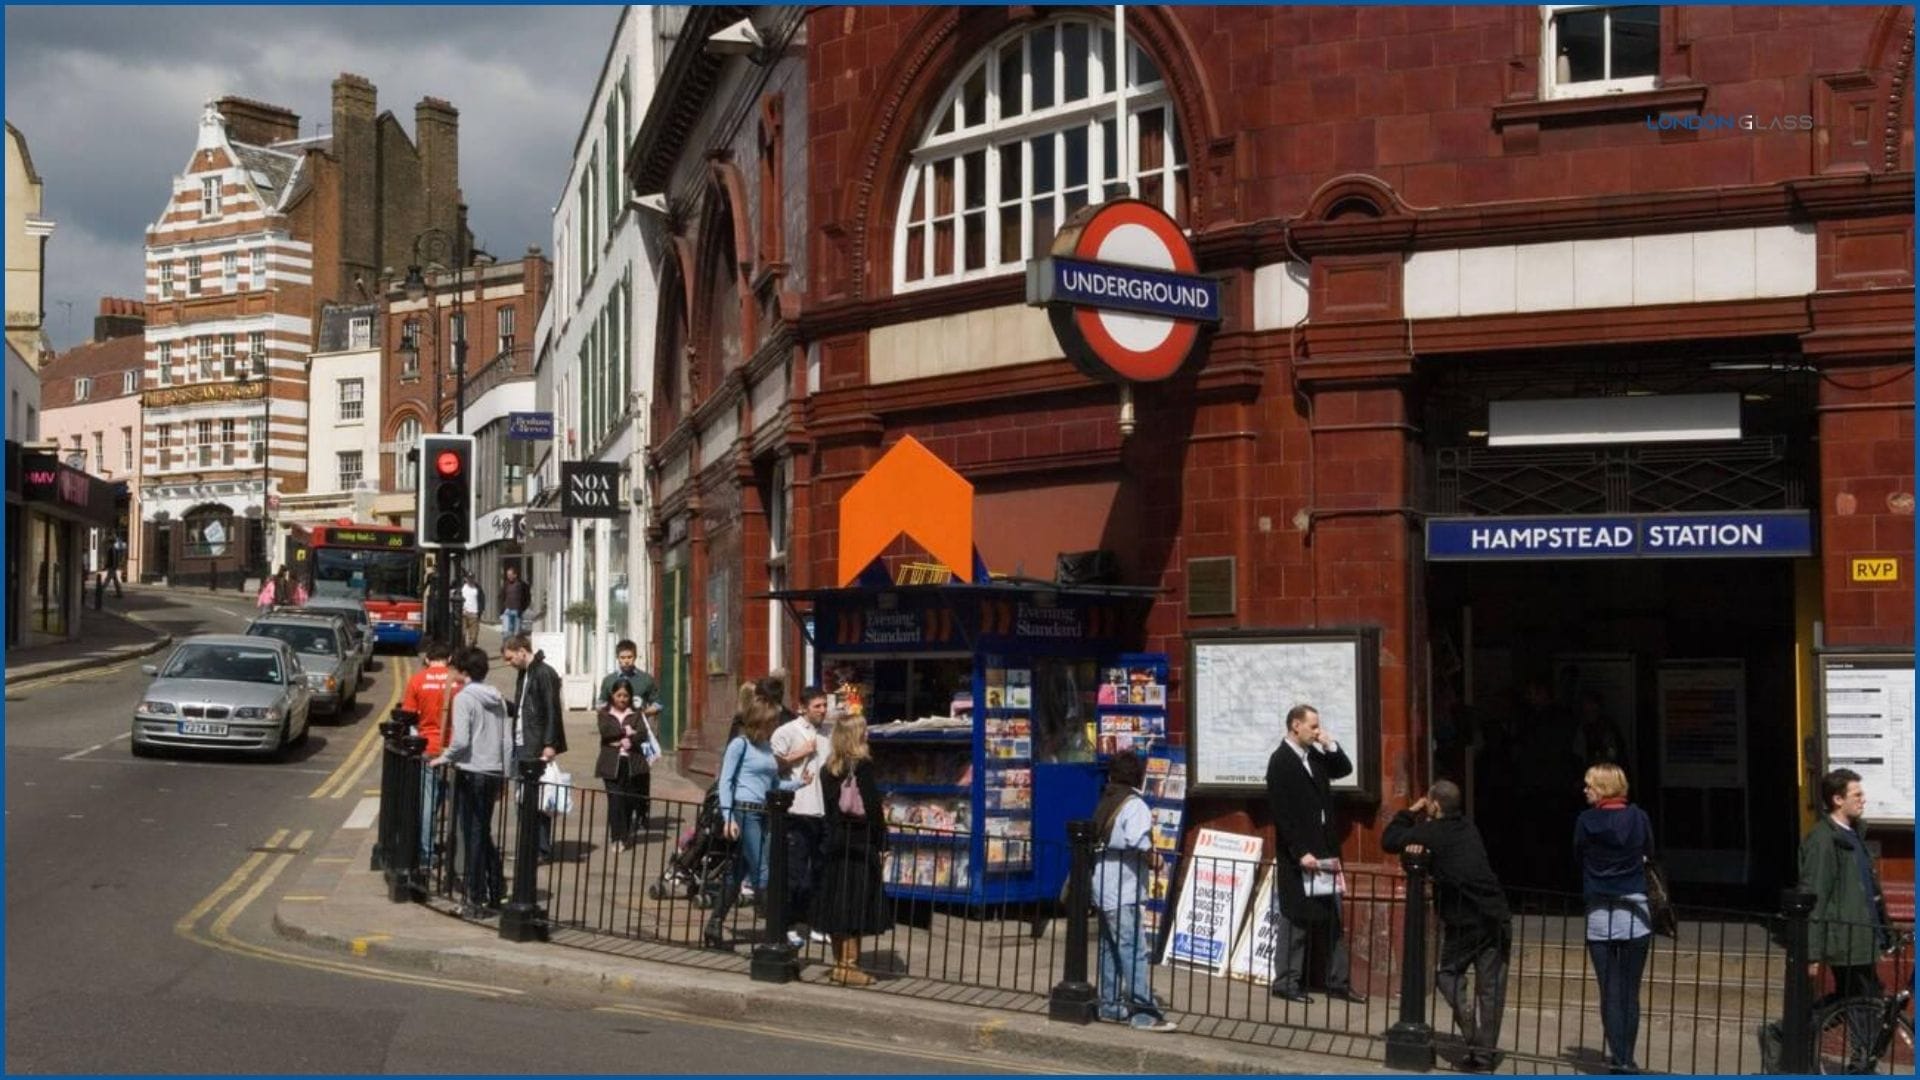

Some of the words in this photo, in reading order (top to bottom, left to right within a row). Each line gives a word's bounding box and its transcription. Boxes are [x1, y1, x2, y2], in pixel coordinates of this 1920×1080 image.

[1062, 269, 1209, 308] UNDERGROUND
[571, 474, 609, 490] NOA
[571, 490, 609, 506] NOA
[1471, 527, 1633, 549] HAMPSTEAD
[1650, 524, 1763, 547] STATION
[1857, 563, 1894, 577] RVP
[866, 612, 914, 627] Evening
[1017, 603, 1076, 622] Evening
[864, 627, 920, 643] Standard
[1016, 620, 1082, 637] Standard
